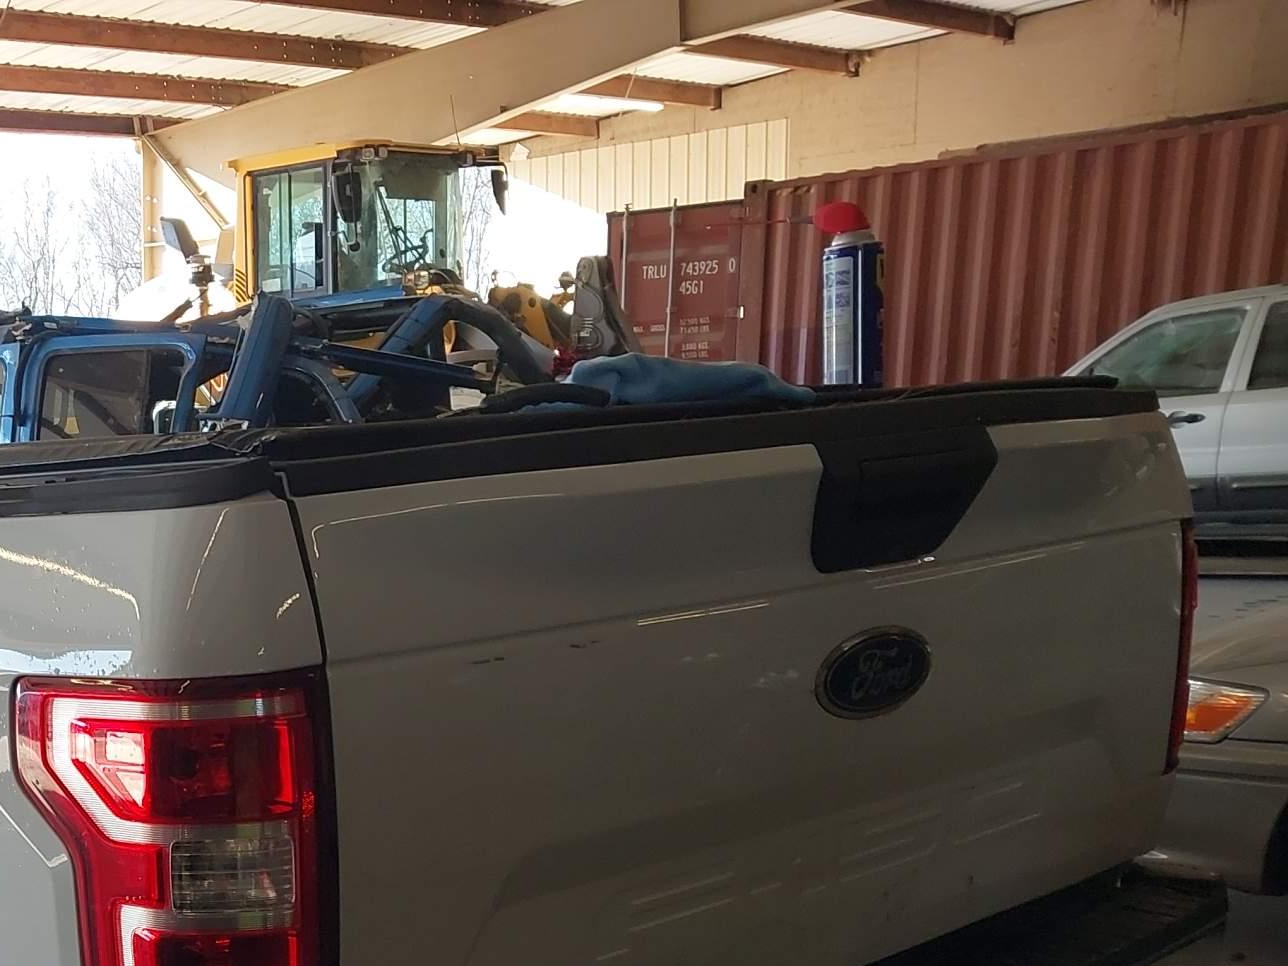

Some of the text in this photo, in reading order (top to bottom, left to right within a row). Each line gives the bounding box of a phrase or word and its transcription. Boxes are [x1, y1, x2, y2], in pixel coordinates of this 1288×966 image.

[642, 264, 667, 280] TRLU
[680, 260, 719, 276] 743925
[679, 280, 704, 295] 45G1
